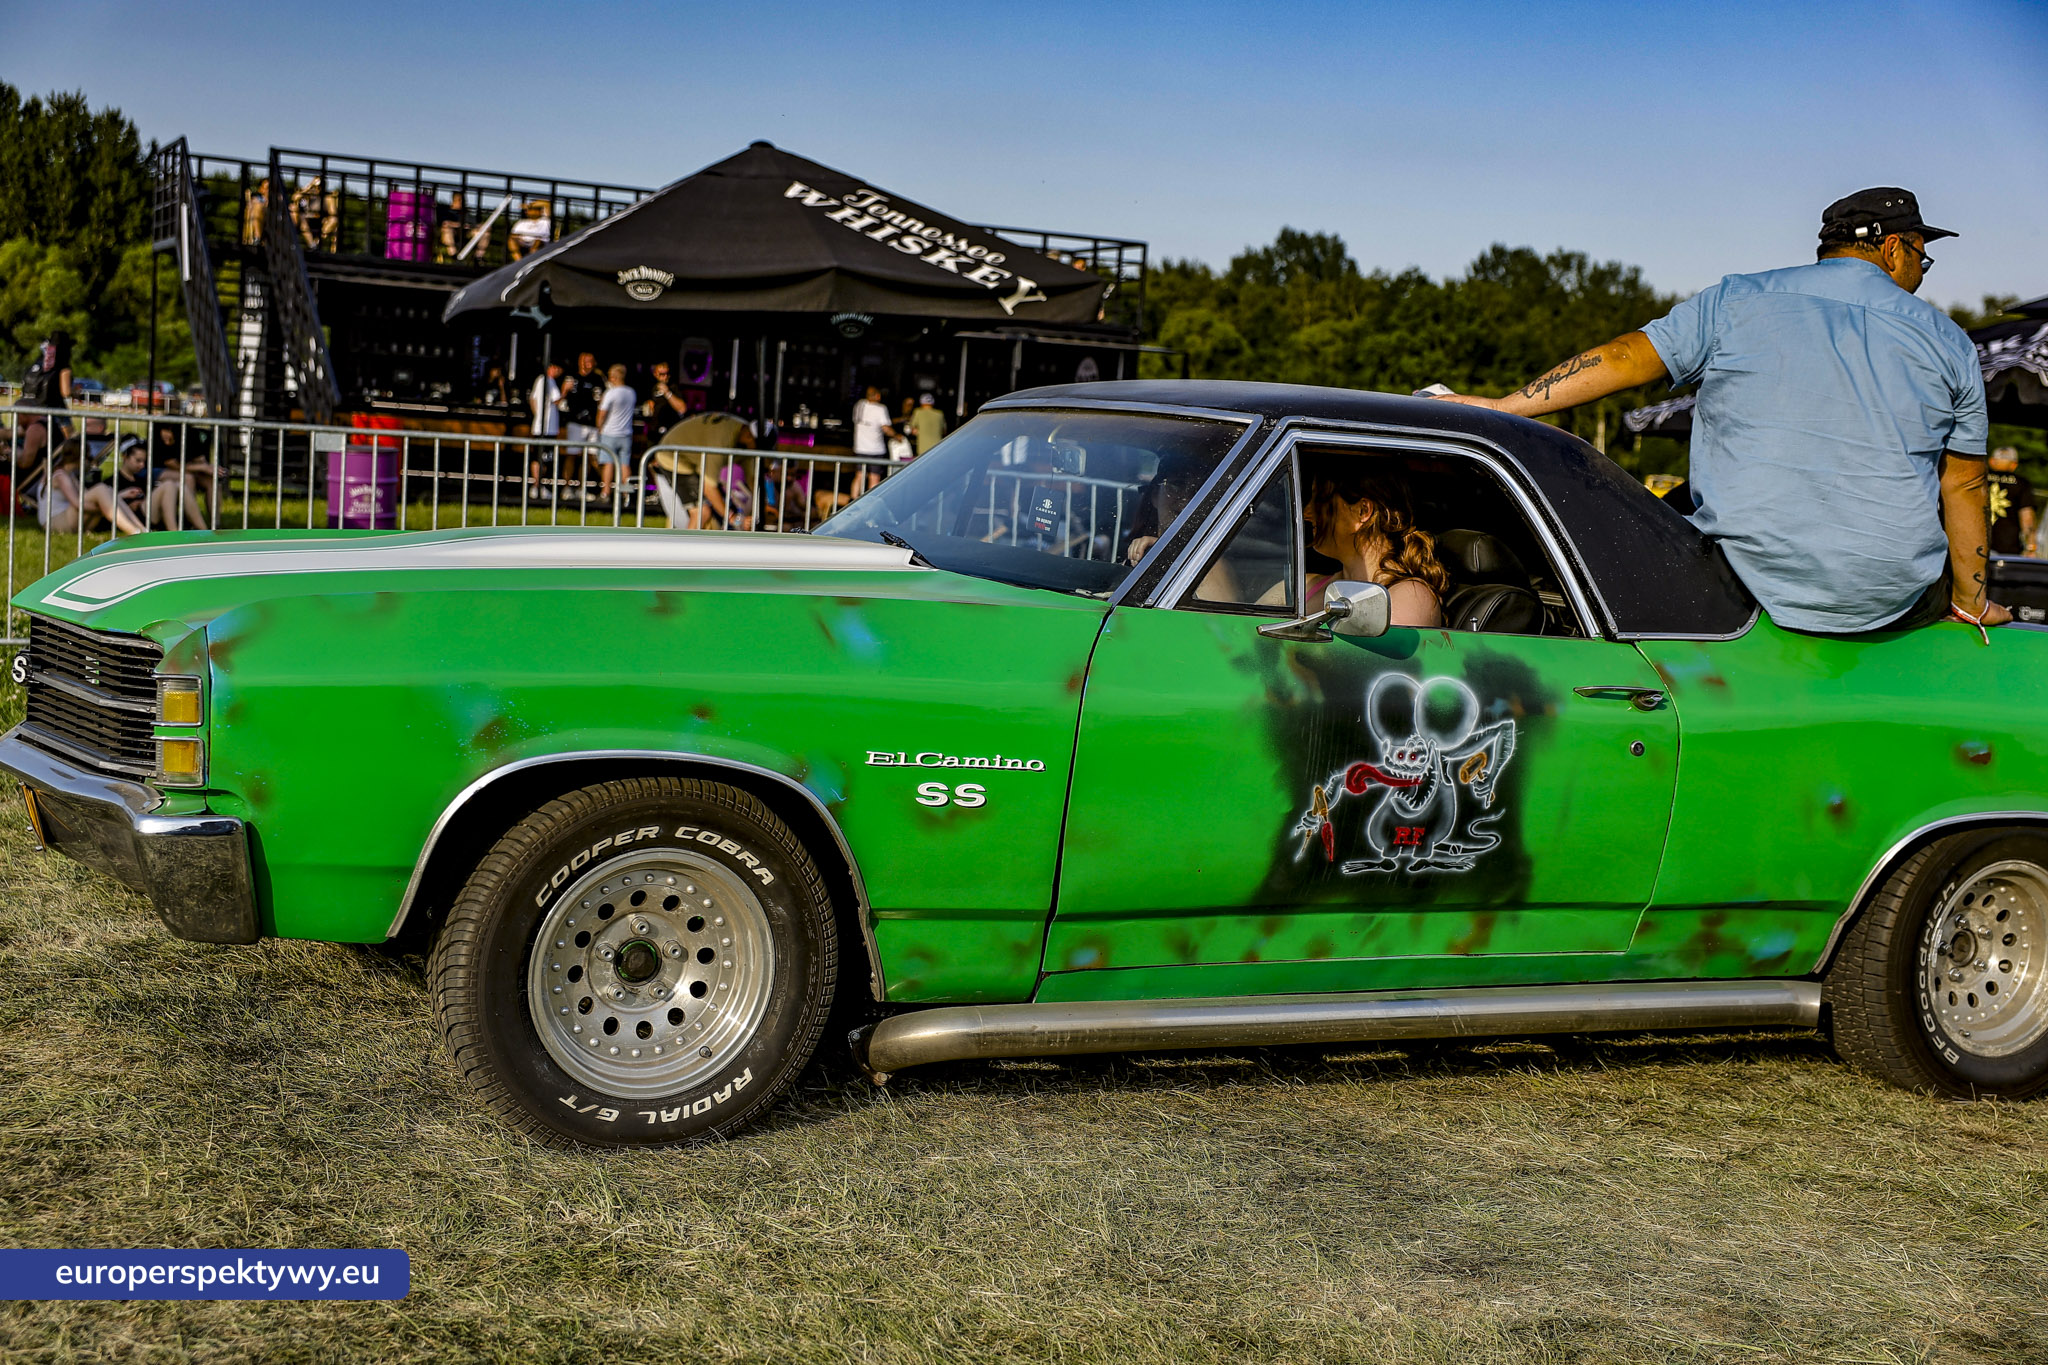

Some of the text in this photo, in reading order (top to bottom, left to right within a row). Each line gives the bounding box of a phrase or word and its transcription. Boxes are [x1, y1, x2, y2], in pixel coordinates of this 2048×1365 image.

[784, 181, 1047, 316] WHISKEY
[842, 188, 1006, 266] Tennessee
[1520, 354, 1602, 400] Carpe Diem
[12, 655, 27, 683] S
[915, 782, 987, 808] SS
[535, 825, 775, 908] COOPER COBRA
[558, 1066, 753, 1125] RADIAL G/T
